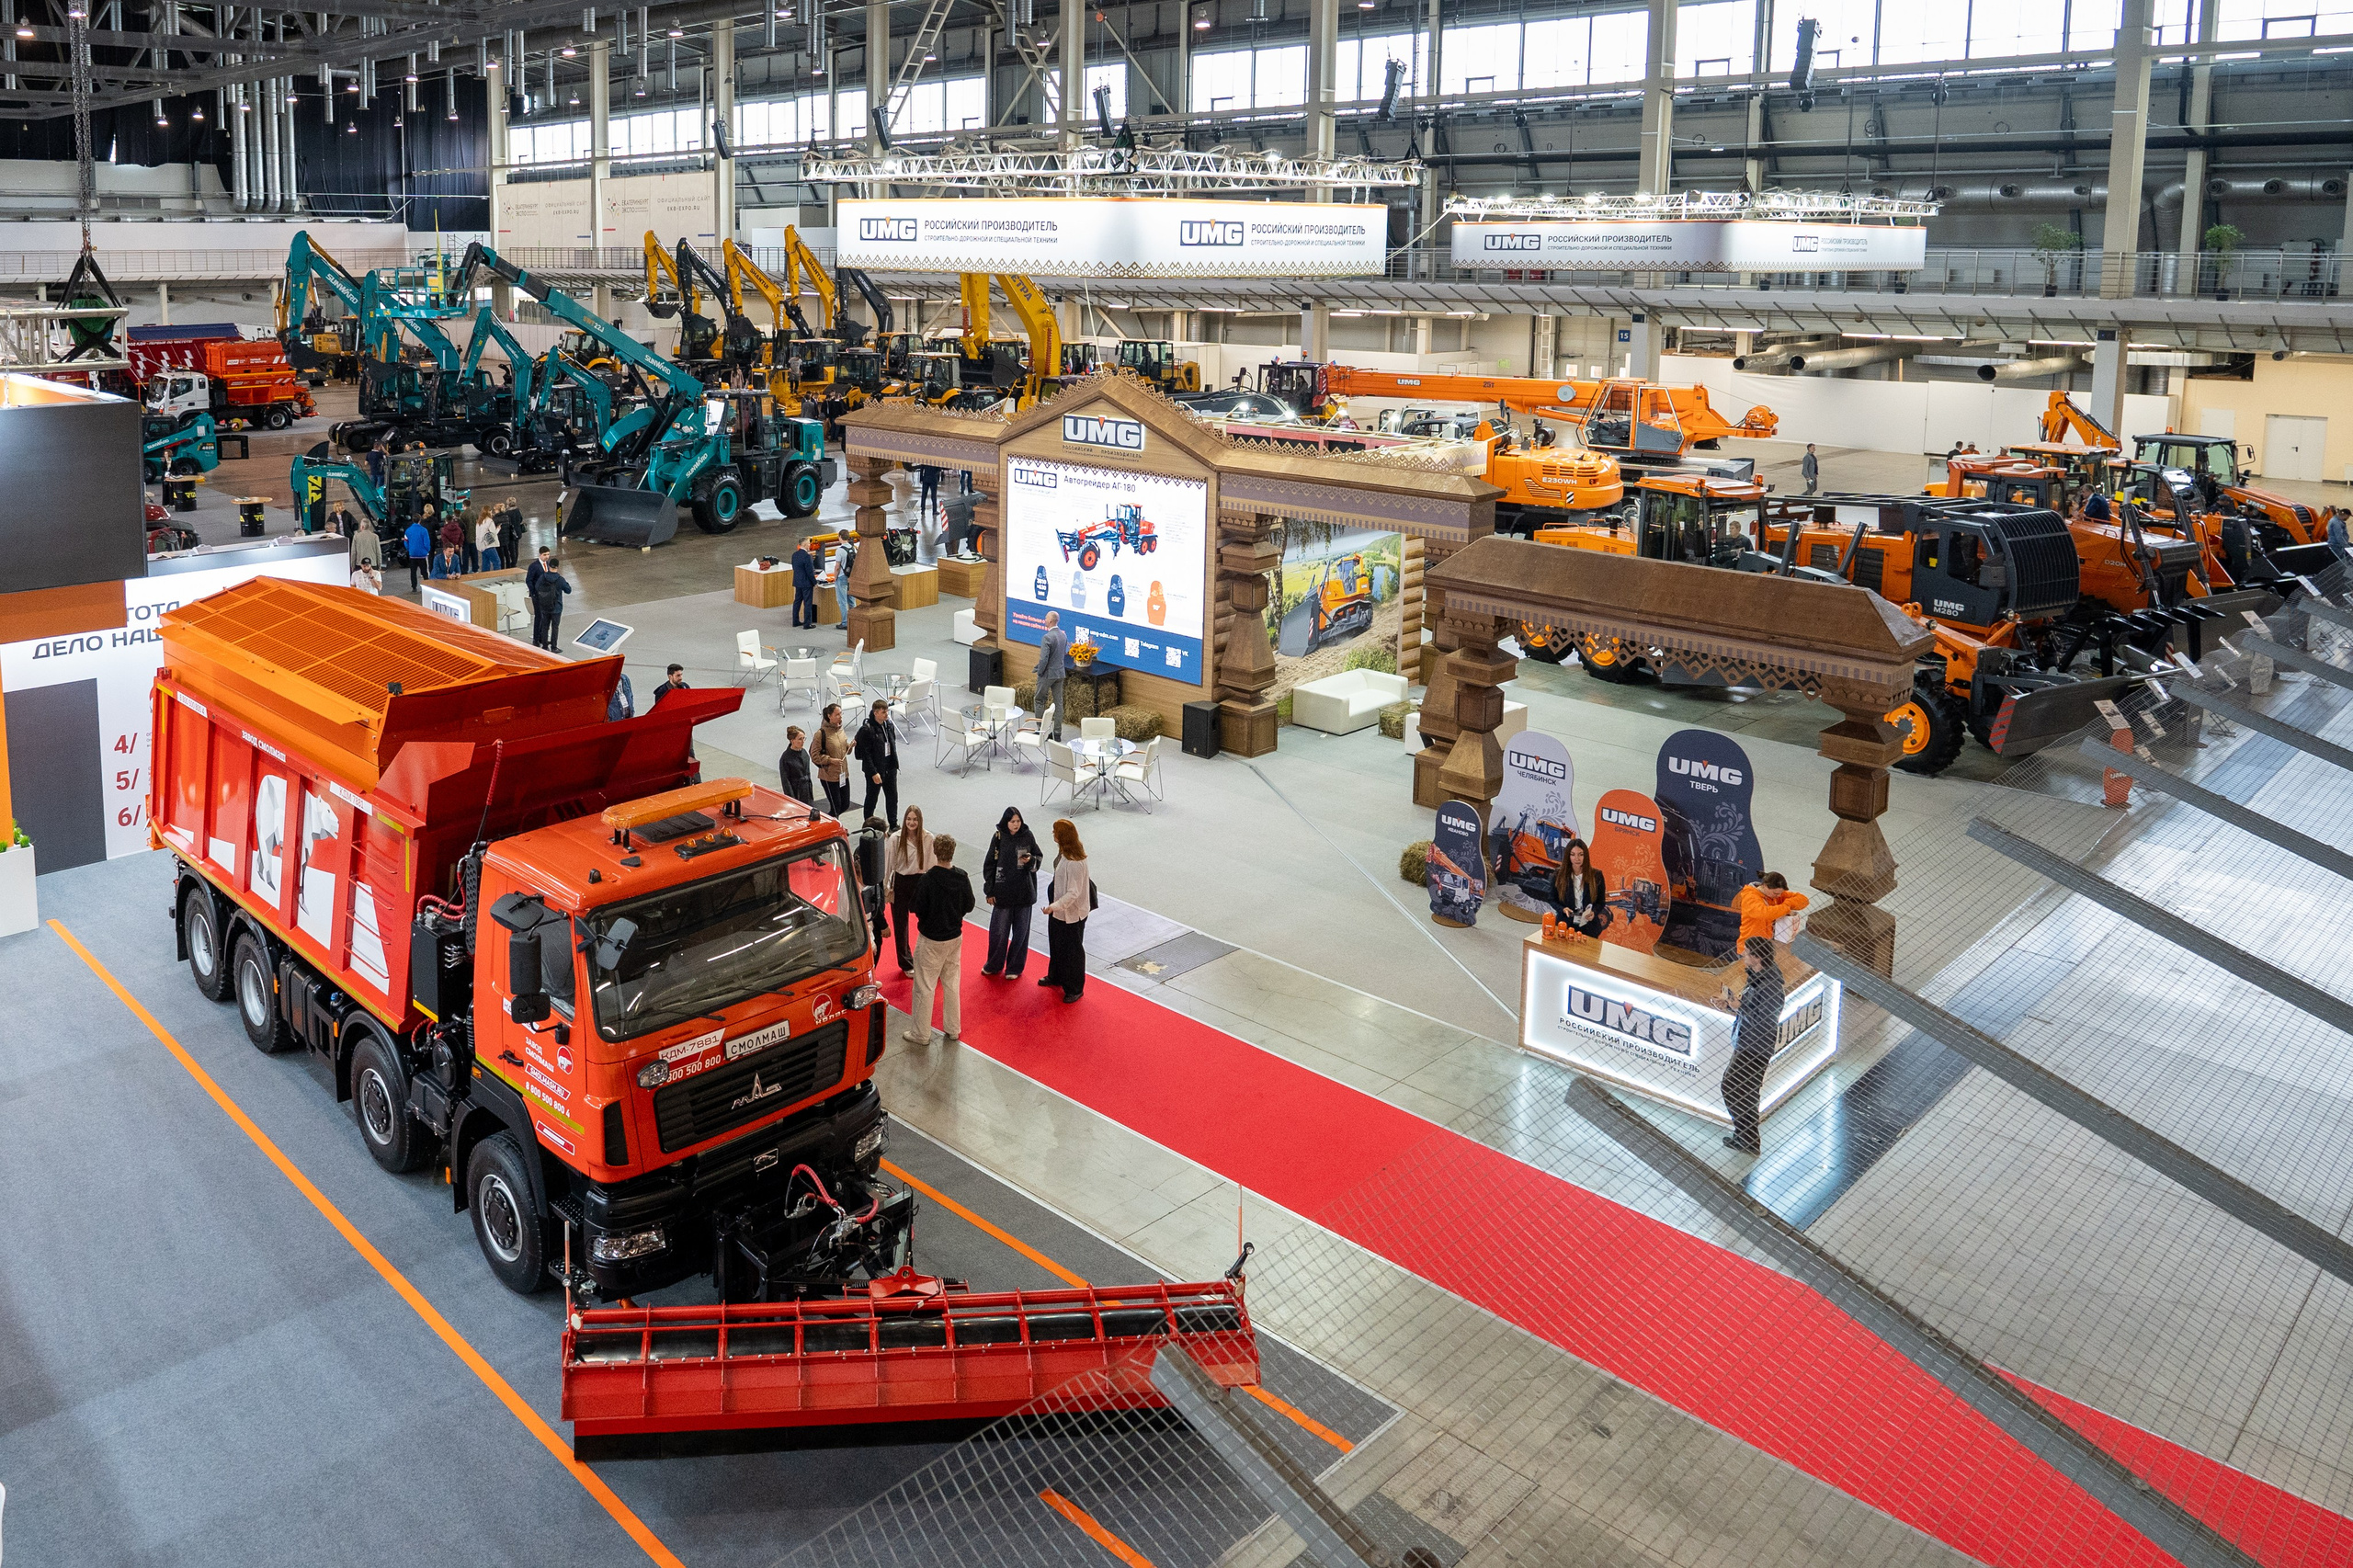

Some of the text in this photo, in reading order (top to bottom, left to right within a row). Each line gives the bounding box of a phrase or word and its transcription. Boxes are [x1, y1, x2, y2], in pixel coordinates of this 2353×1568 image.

[861, 219, 917, 241] UMG
[925, 219, 1058, 233] РОССИЙСКИЙ ПРОИЗВОДИТЕЛЬ
[1181, 221, 1244, 246] UMG
[1251, 222, 1366, 236] РОССИЙСКИЙ ПРОИЗВОДИТЕЛЬ
[1485, 234, 1540, 250] UMG
[1548, 233, 1673, 244] РОССИЙСКИЙ ПРОИЗВОДИТЕЛЬ
[1793, 236, 1818, 252] UMG
[702, 268, 721, 290] HYUNDAI
[749, 267, 769, 290] SHANTUI
[807, 258, 824, 283] SHANTUI
[325, 273, 358, 304] SUNWARD
[858, 275, 871, 292] HYUNDAI
[1010, 275, 1032, 301] ЕТРА
[644, 355, 671, 375] SUNWARD
[1064, 416, 1141, 448] UMG
[146, 438, 170, 449] SUNWARD
[1101, 449, 1142, 459] ПРОИЗВОДИТЕЛЬ
[686, 452, 709, 479] SUNWARD
[1015, 470, 1057, 488] UMG
[1063, 475, 1110, 491] Автогрейдер
[1541, 476, 1577, 485] E230WH
[2245, 499, 2267, 510] UMG
[127, 601, 180, 621] ТОТА
[1933, 607, 1960, 618] M280
[1934, 599, 1965, 612] UMG
[32, 628, 163, 659] ДЕЛО НАШ
[1140, 641, 1159, 651] Telegram
[114, 733, 138, 754] 4/
[1510, 752, 1565, 778] UMG
[1668, 756, 1743, 786] UMG
[116, 768, 140, 790] 5/
[1518, 770, 1557, 786] ЧЕЛЯБИНСК
[1689, 780, 1719, 793] ТВЕРЬ
[339, 788, 364, 809] КДМ 7881
[118, 804, 142, 826] 6/
[1441, 814, 1476, 833] UMG
[1602, 808, 1655, 832] UMG
[1448, 827, 1469, 837] ИВАНОВО
[1614, 826, 1641, 837] БРЯНСК
[1569, 987, 1691, 1055] UMG
[526, 1037, 542, 1055] ЗАВОД
[661, 1036, 720, 1061] КДМ-7881
[731, 1027, 786, 1055] СМОЛМАШ
[1559, 1017, 1700, 1074] РОССИЙСКИЙ ПРОИЗВОДИТЕЛЬ
[526, 1047, 554, 1073] СМОЛМАШ
[686, 1062, 702, 1075] 500
[704, 1054, 721, 1069] 800
[529, 1067, 565, 1096] SMOLMASH.RU
[1670, 1065, 1697, 1078] ТЕХНИКИ
[526, 1082, 570, 1118] 8 800 500 800 4
